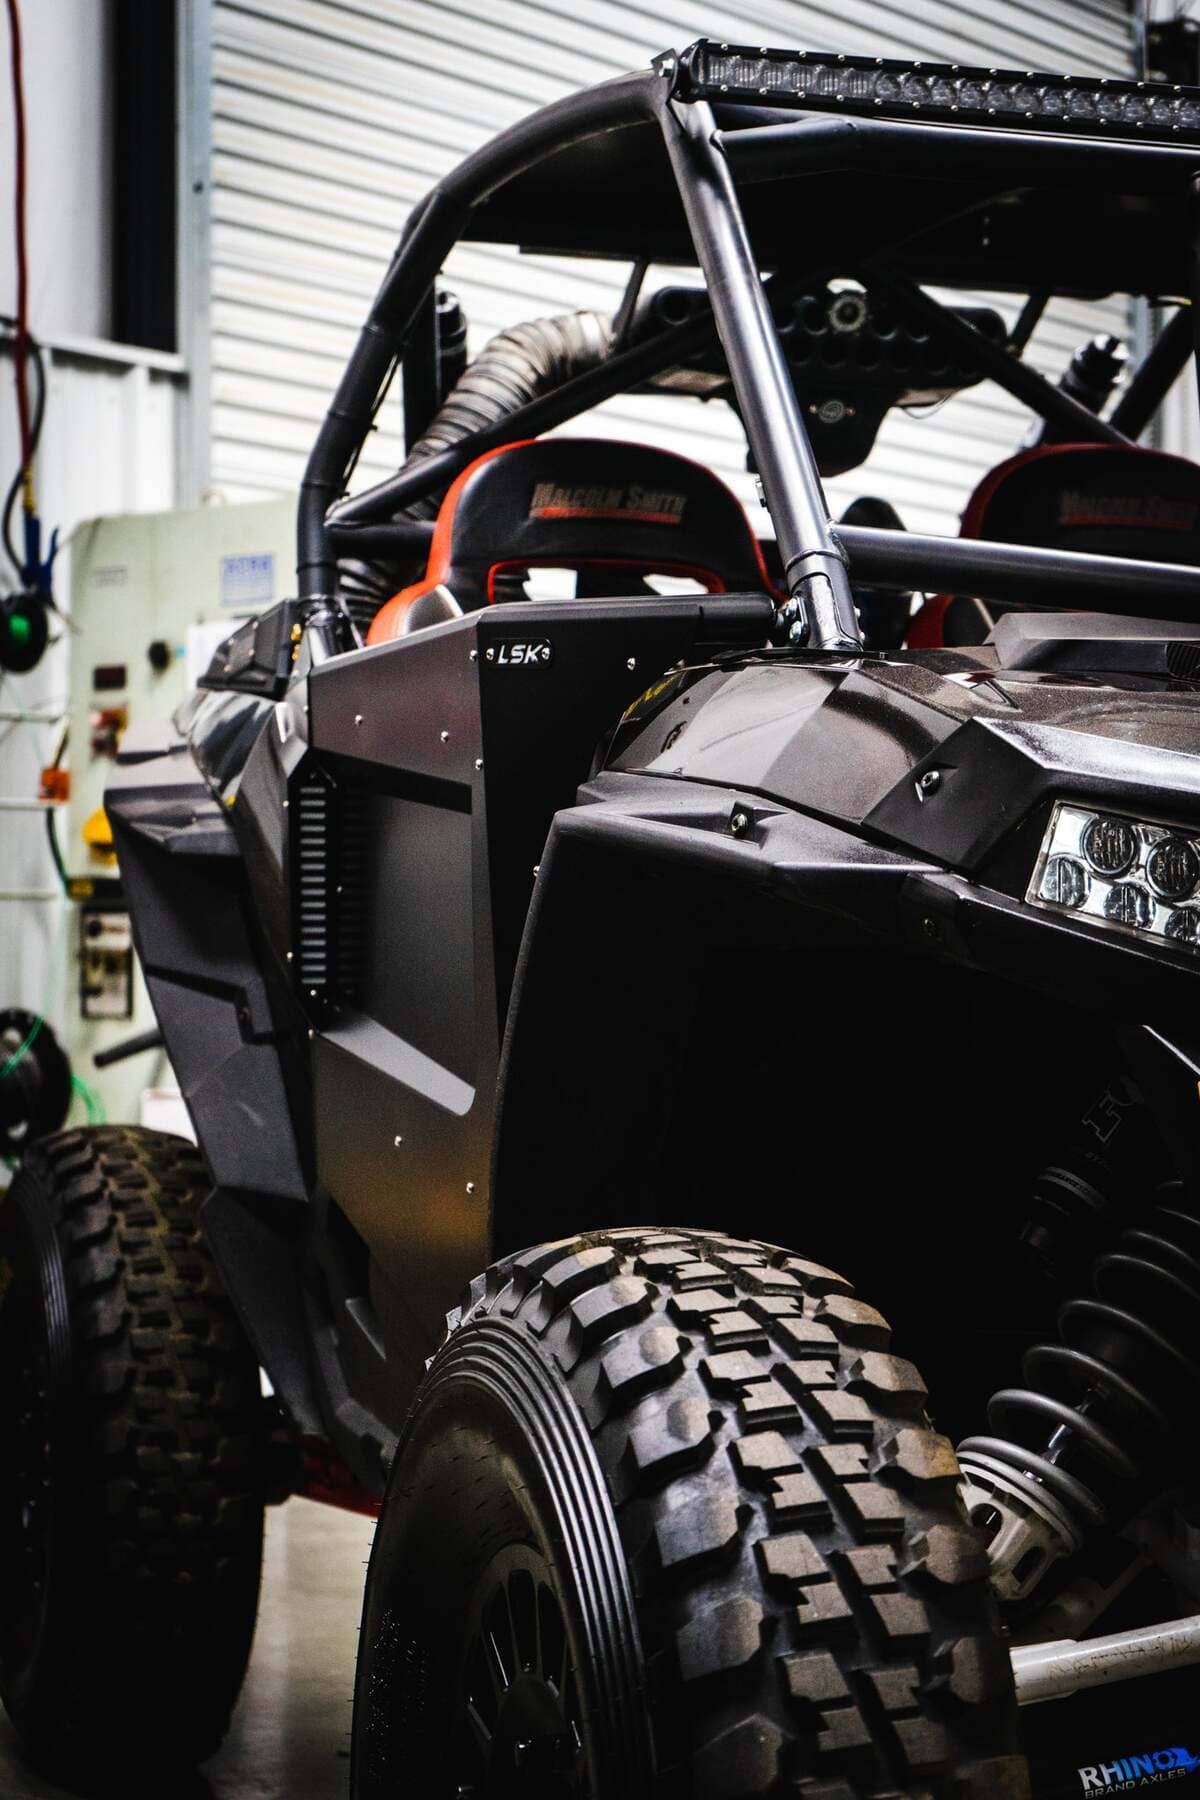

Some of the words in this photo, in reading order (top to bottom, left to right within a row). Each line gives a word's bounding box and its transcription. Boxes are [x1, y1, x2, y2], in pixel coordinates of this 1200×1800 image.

[532, 483, 622, 508] MALCOLM
[628, 486, 688, 513] SMITH
[496, 644, 544, 664] LSK
[1077, 1750, 1177, 1791] RHINO
[1084, 1780, 1136, 1799] BRAND
[1140, 1767, 1186, 1786] AXLES
